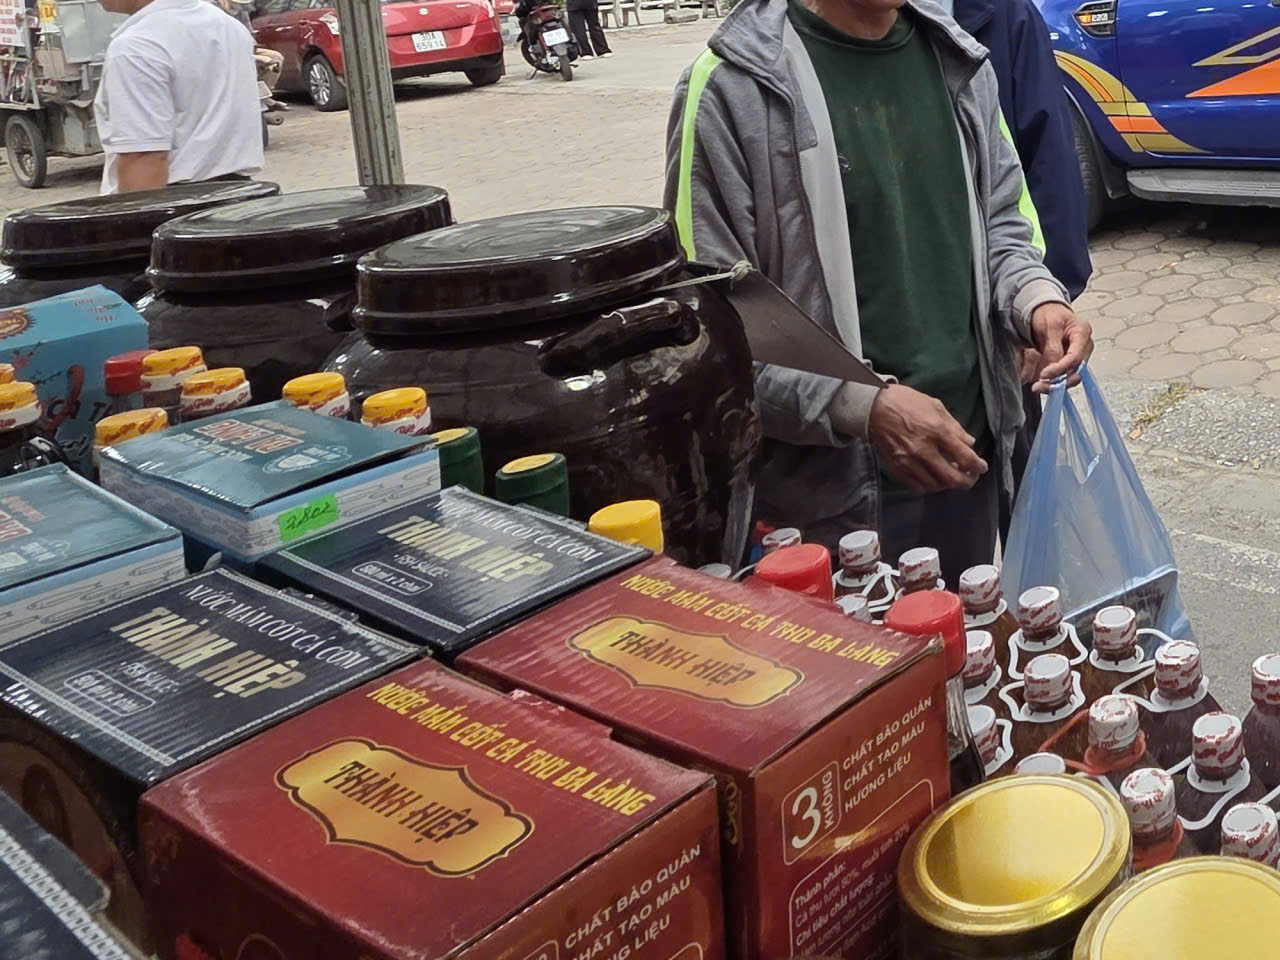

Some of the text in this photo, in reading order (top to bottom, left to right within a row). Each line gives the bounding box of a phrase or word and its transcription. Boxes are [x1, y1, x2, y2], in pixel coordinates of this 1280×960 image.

[110, 606, 306, 699] THÀNH HIỆP
[179, 584, 370, 670] NƯỚC MẮM CỐT CÁ CƠM
[609, 631, 756, 688] THÀNH HIỆP
[620, 574, 900, 668] NƯỚC MẮM CỐT CÁ THU BA LÀNG
[366, 682, 657, 817] NƯỚC MẮM CỐT CÁ THU BA LÀNG
[842, 696, 932, 771] CHẤT BẢO QUẢN
[843, 721, 926, 792] CHẤT TẠO MÀU
[323, 760, 480, 844] THÀNH HIỆP
[791, 787, 821, 849] 3
[822, 770, 834, 830] KHÔNG
[845, 752, 911, 813] HƯƠNG LIỆU
[564, 843, 701, 950] CHẤT BẢO QUẢN
[571, 933, 615, 960] HẤT
[618, 904, 653, 937] TẠO
[656, 875, 692, 908] MÀU
[634, 914, 671, 950] LIỆU
